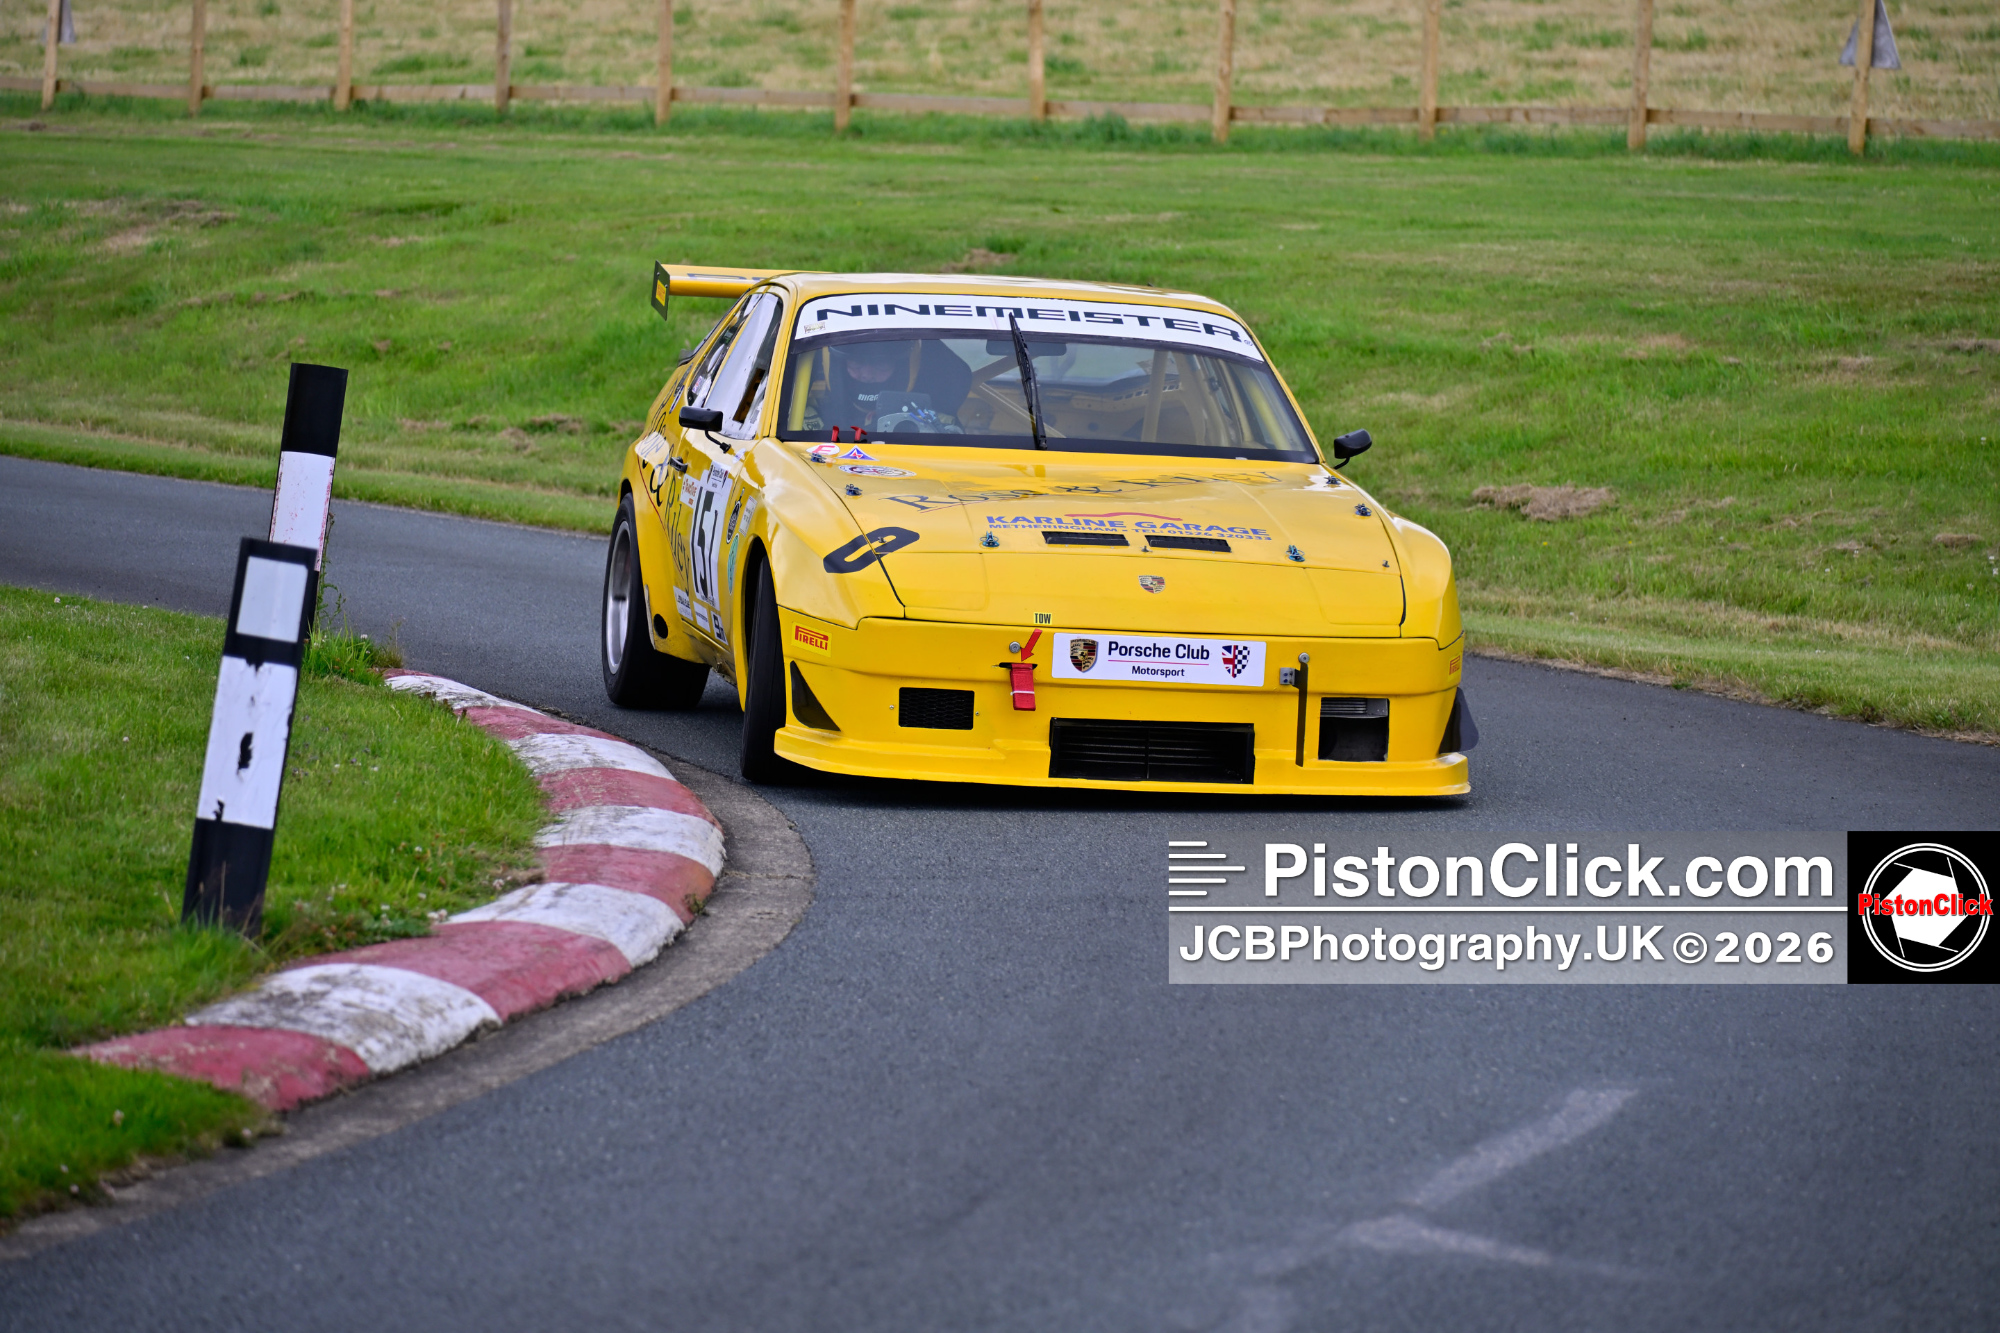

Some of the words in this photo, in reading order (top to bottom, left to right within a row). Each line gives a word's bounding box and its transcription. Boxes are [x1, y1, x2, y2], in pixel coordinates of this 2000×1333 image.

[817, 303, 1242, 343] NINEMEISTER
[986, 515, 1127, 529] KARLINE
[1135, 521, 1270, 537] GARAGE
[989, 524, 1118, 533] METHERINGHAM
[1168, 529, 1213, 537] 01526
[1035, 613, 1051, 624] TOW
[795, 625, 829, 650] PIRELLI
[1108, 641, 1171, 658] Porsche
[1175, 643, 1210, 660] Club
[1132, 665, 1185, 678] Motorsport
